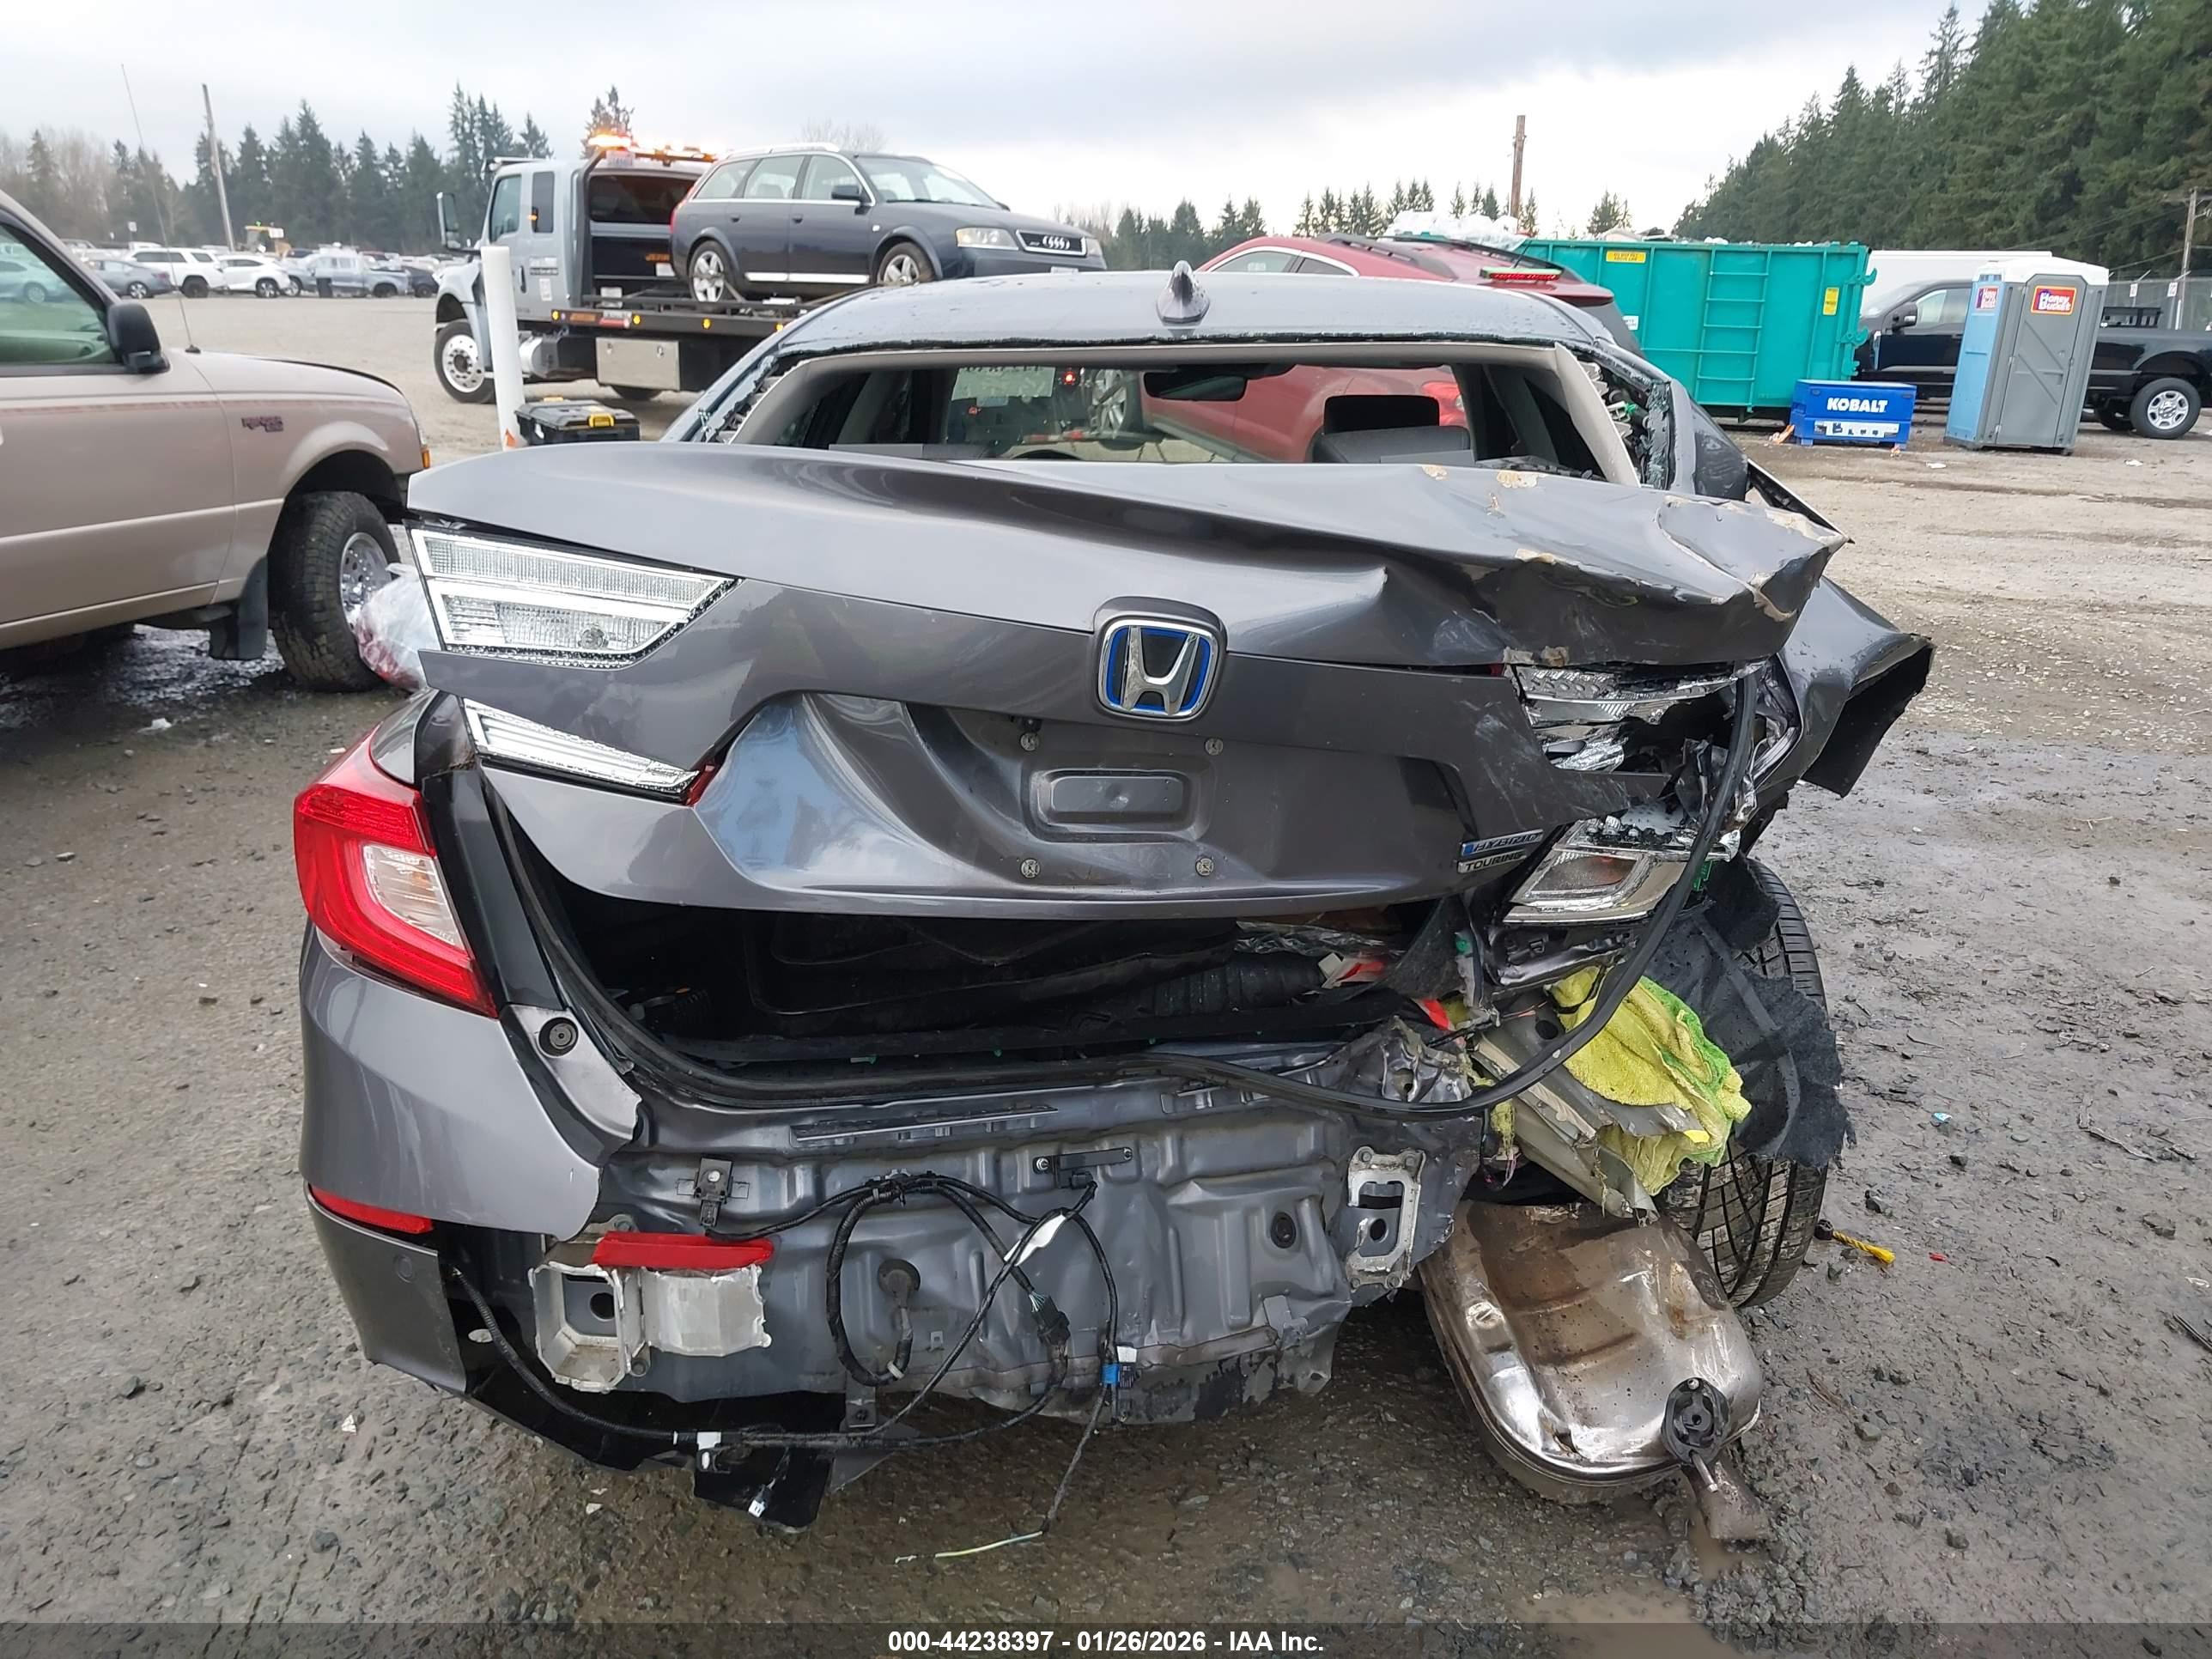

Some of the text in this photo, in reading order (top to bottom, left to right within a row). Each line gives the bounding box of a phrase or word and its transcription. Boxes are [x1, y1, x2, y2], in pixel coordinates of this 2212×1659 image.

[2040, 292, 2070, 303] Honey
[1826, 398, 1888, 413] KOBALT
[1466, 852, 1527, 871] TOURING
